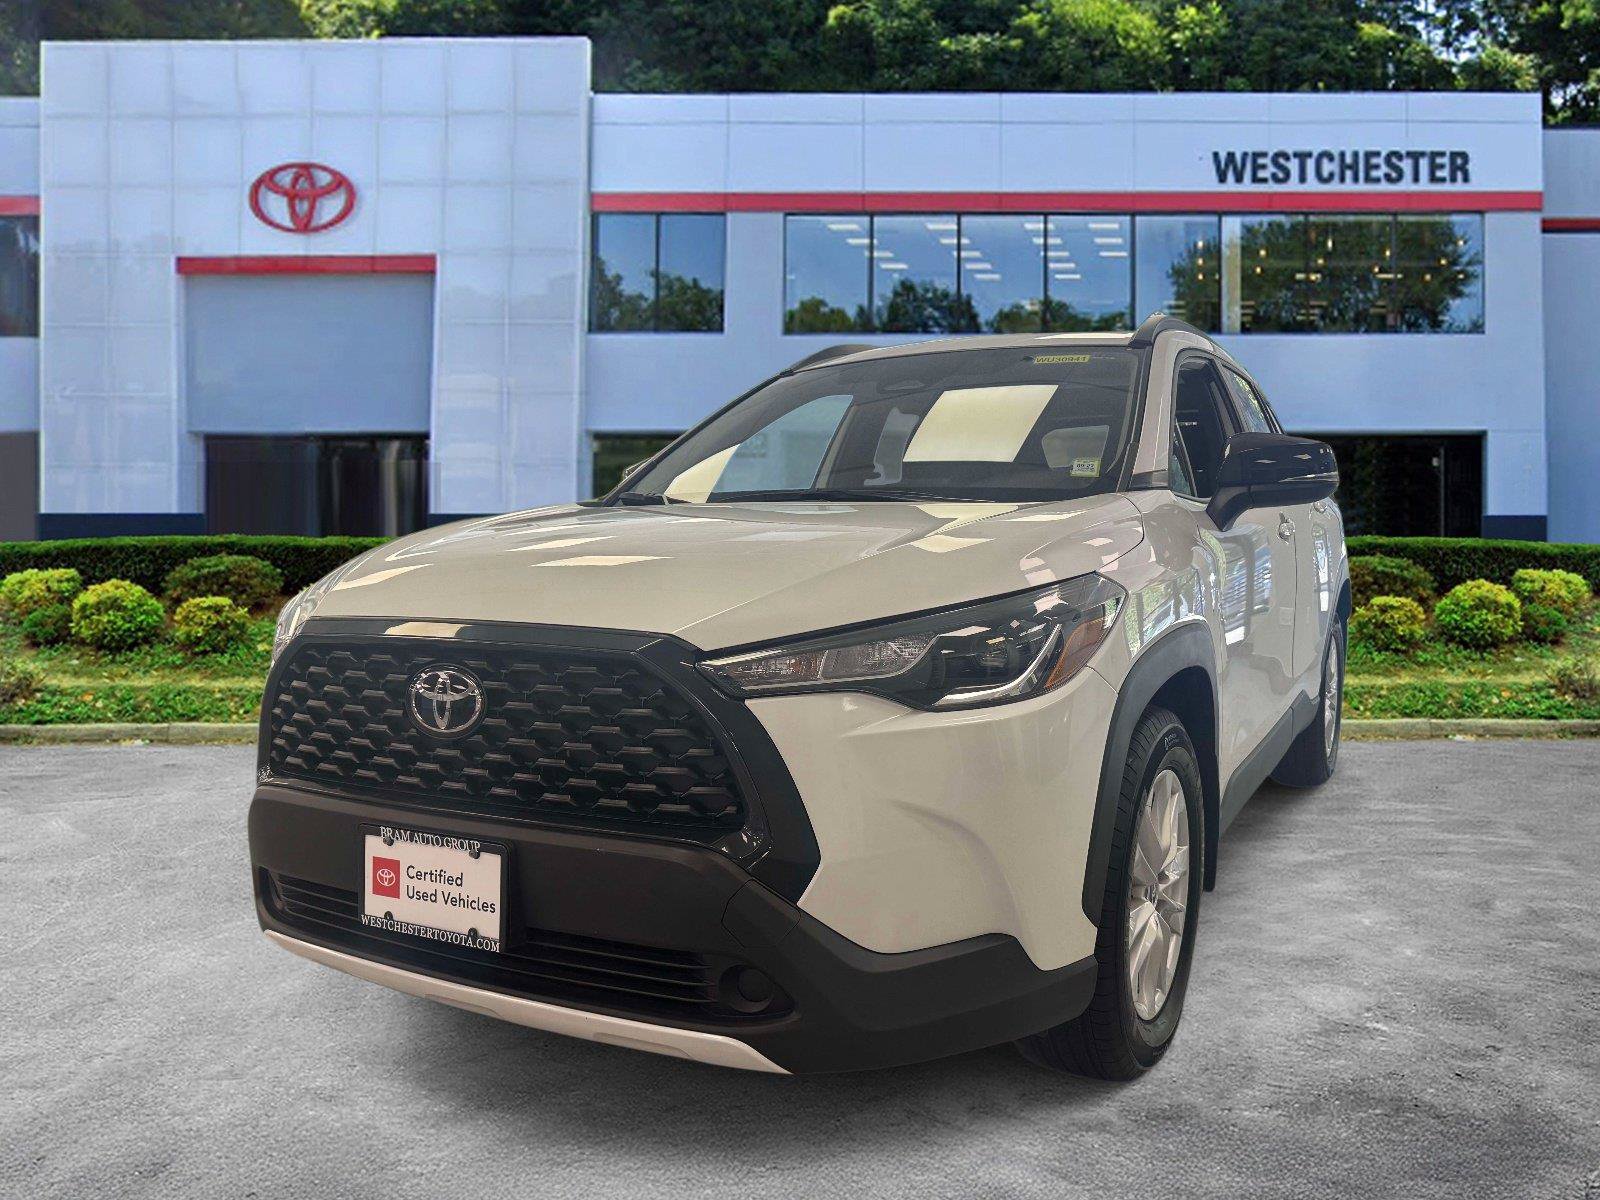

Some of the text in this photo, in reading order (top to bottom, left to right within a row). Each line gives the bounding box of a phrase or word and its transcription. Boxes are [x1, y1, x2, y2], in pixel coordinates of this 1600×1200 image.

[1212, 150, 1471, 184] WESTCHESTER
[380, 826, 481, 852] BRAM AUTO GROUP
[406, 865, 463, 887] Certified
[406, 885, 496, 914] Used Vehicles
[361, 914, 500, 953] WESTCHESTERTOYOTA.COM
